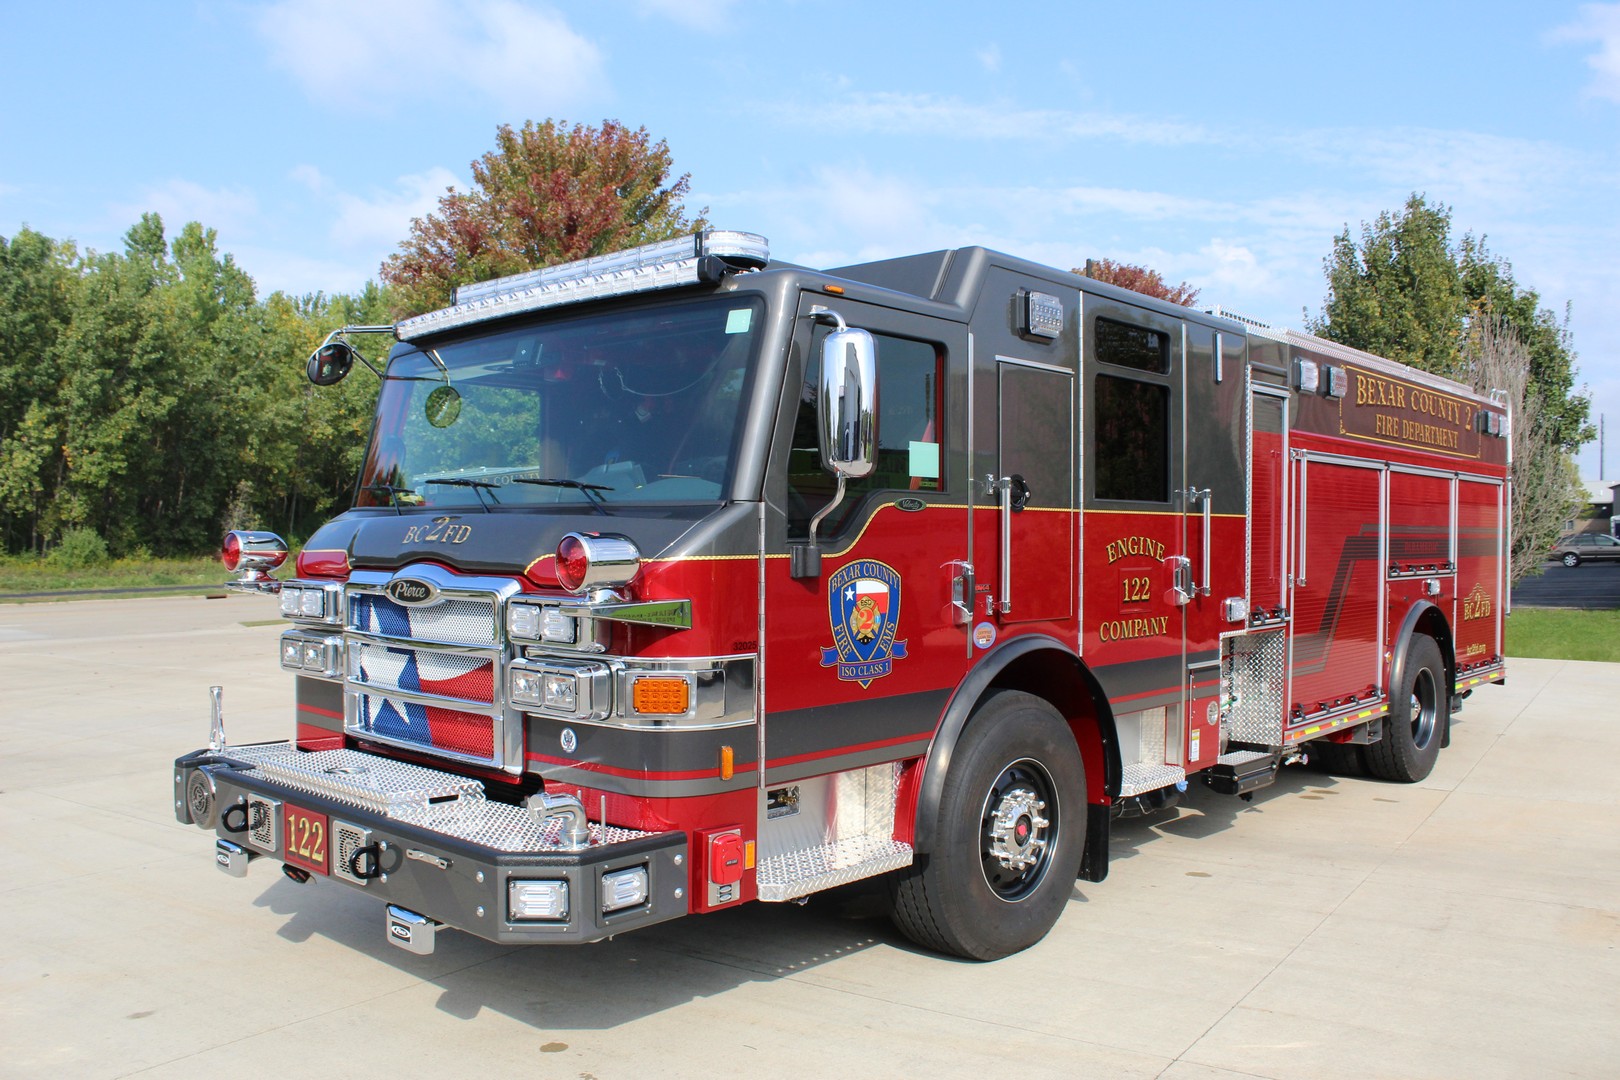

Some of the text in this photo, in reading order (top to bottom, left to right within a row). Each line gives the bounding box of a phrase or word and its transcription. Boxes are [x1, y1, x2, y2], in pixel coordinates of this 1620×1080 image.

[1356, 374, 1472, 431] BEXAR COUNTY 2
[1375, 413, 1459, 449] FIRE DEPARTMENT
[402, 516, 472, 544] BC2FD
[1106, 536, 1165, 563] ENGINE
[394, 581, 426, 598] Pierce
[831, 562, 899, 593] BEXAR COUNTY
[1123, 577, 1151, 602] 122
[859, 609, 873, 629] 2
[1464, 592, 1491, 620] BC2FD
[834, 623, 853, 659] FIRE
[879, 621, 895, 653] EMS
[1100, 616, 1168, 641] COMPANY
[733, 640, 757, 651] 32025
[841, 663, 889, 677] ISO CLASS 1
[288, 814, 325, 863] 122
